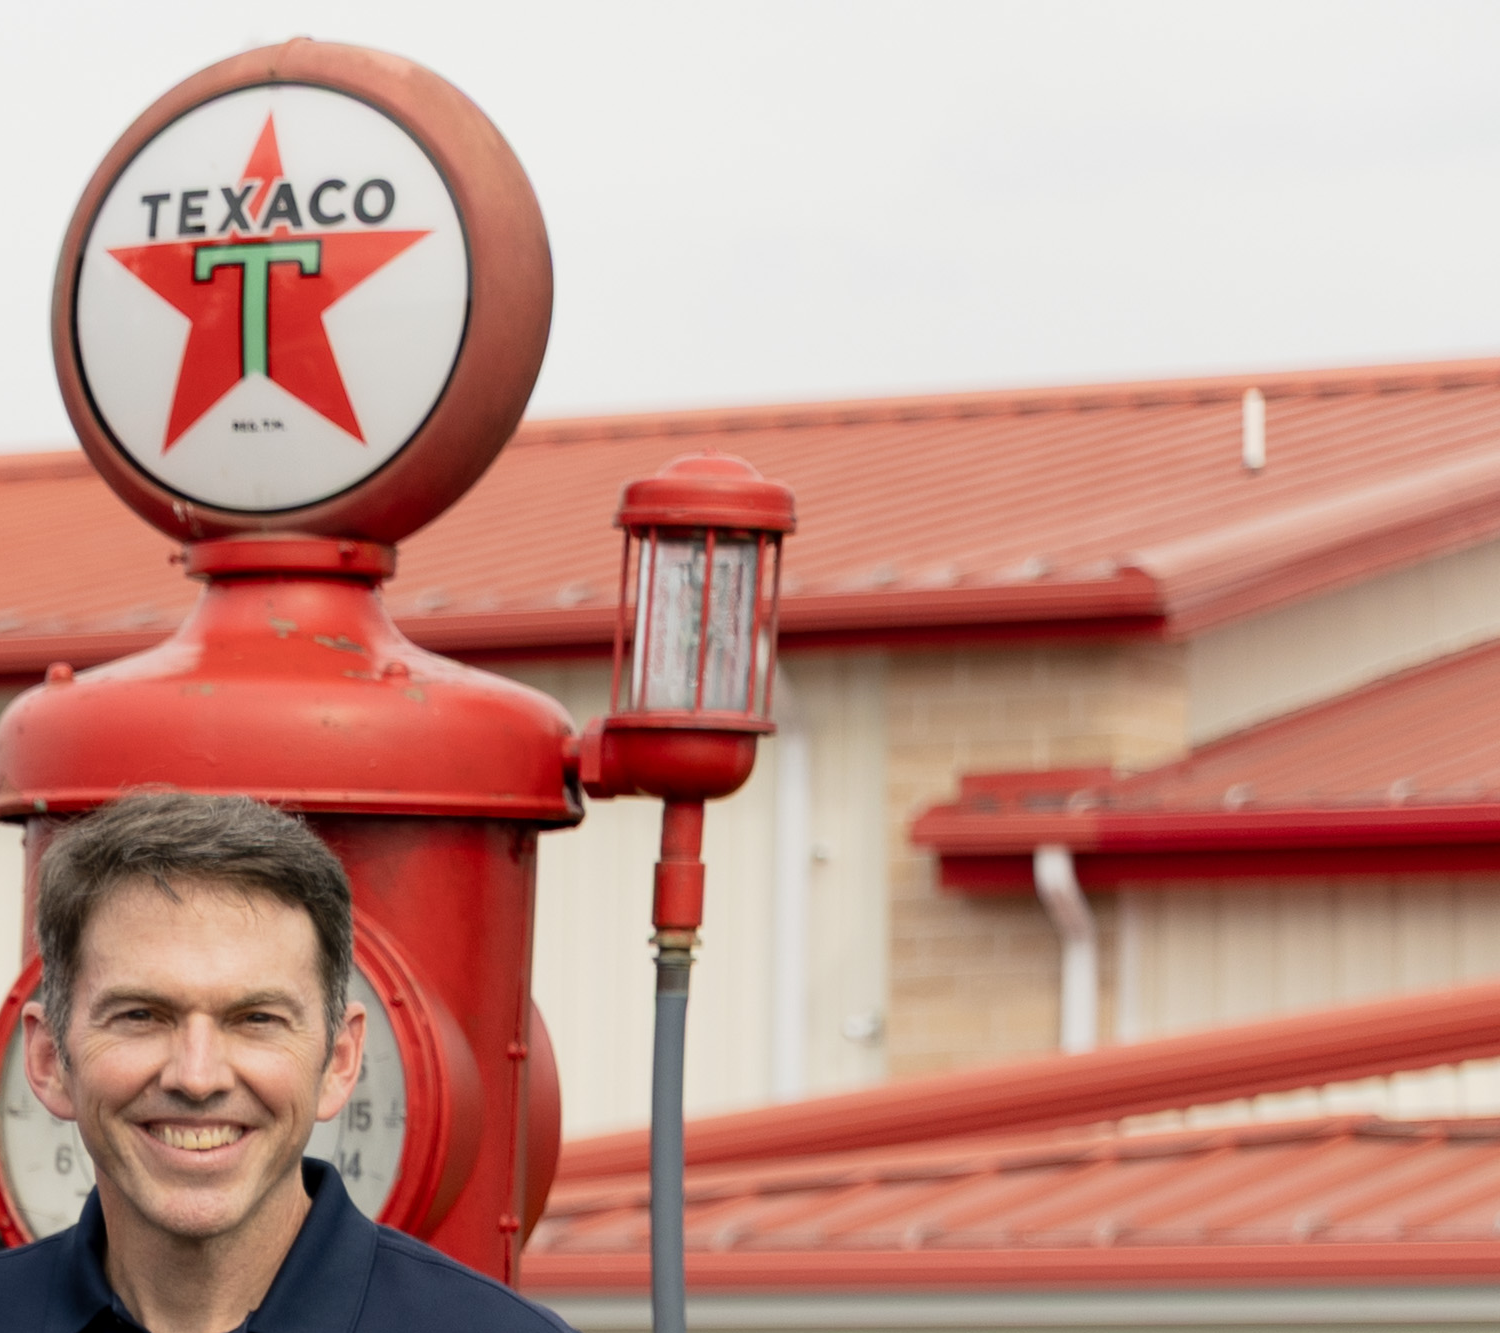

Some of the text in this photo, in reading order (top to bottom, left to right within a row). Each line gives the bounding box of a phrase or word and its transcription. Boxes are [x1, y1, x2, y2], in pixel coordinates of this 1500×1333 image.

[141, 179, 396, 239] TEXACO
[348, 1100, 373, 1133] 15
[54, 1144, 73, 1176] 6
